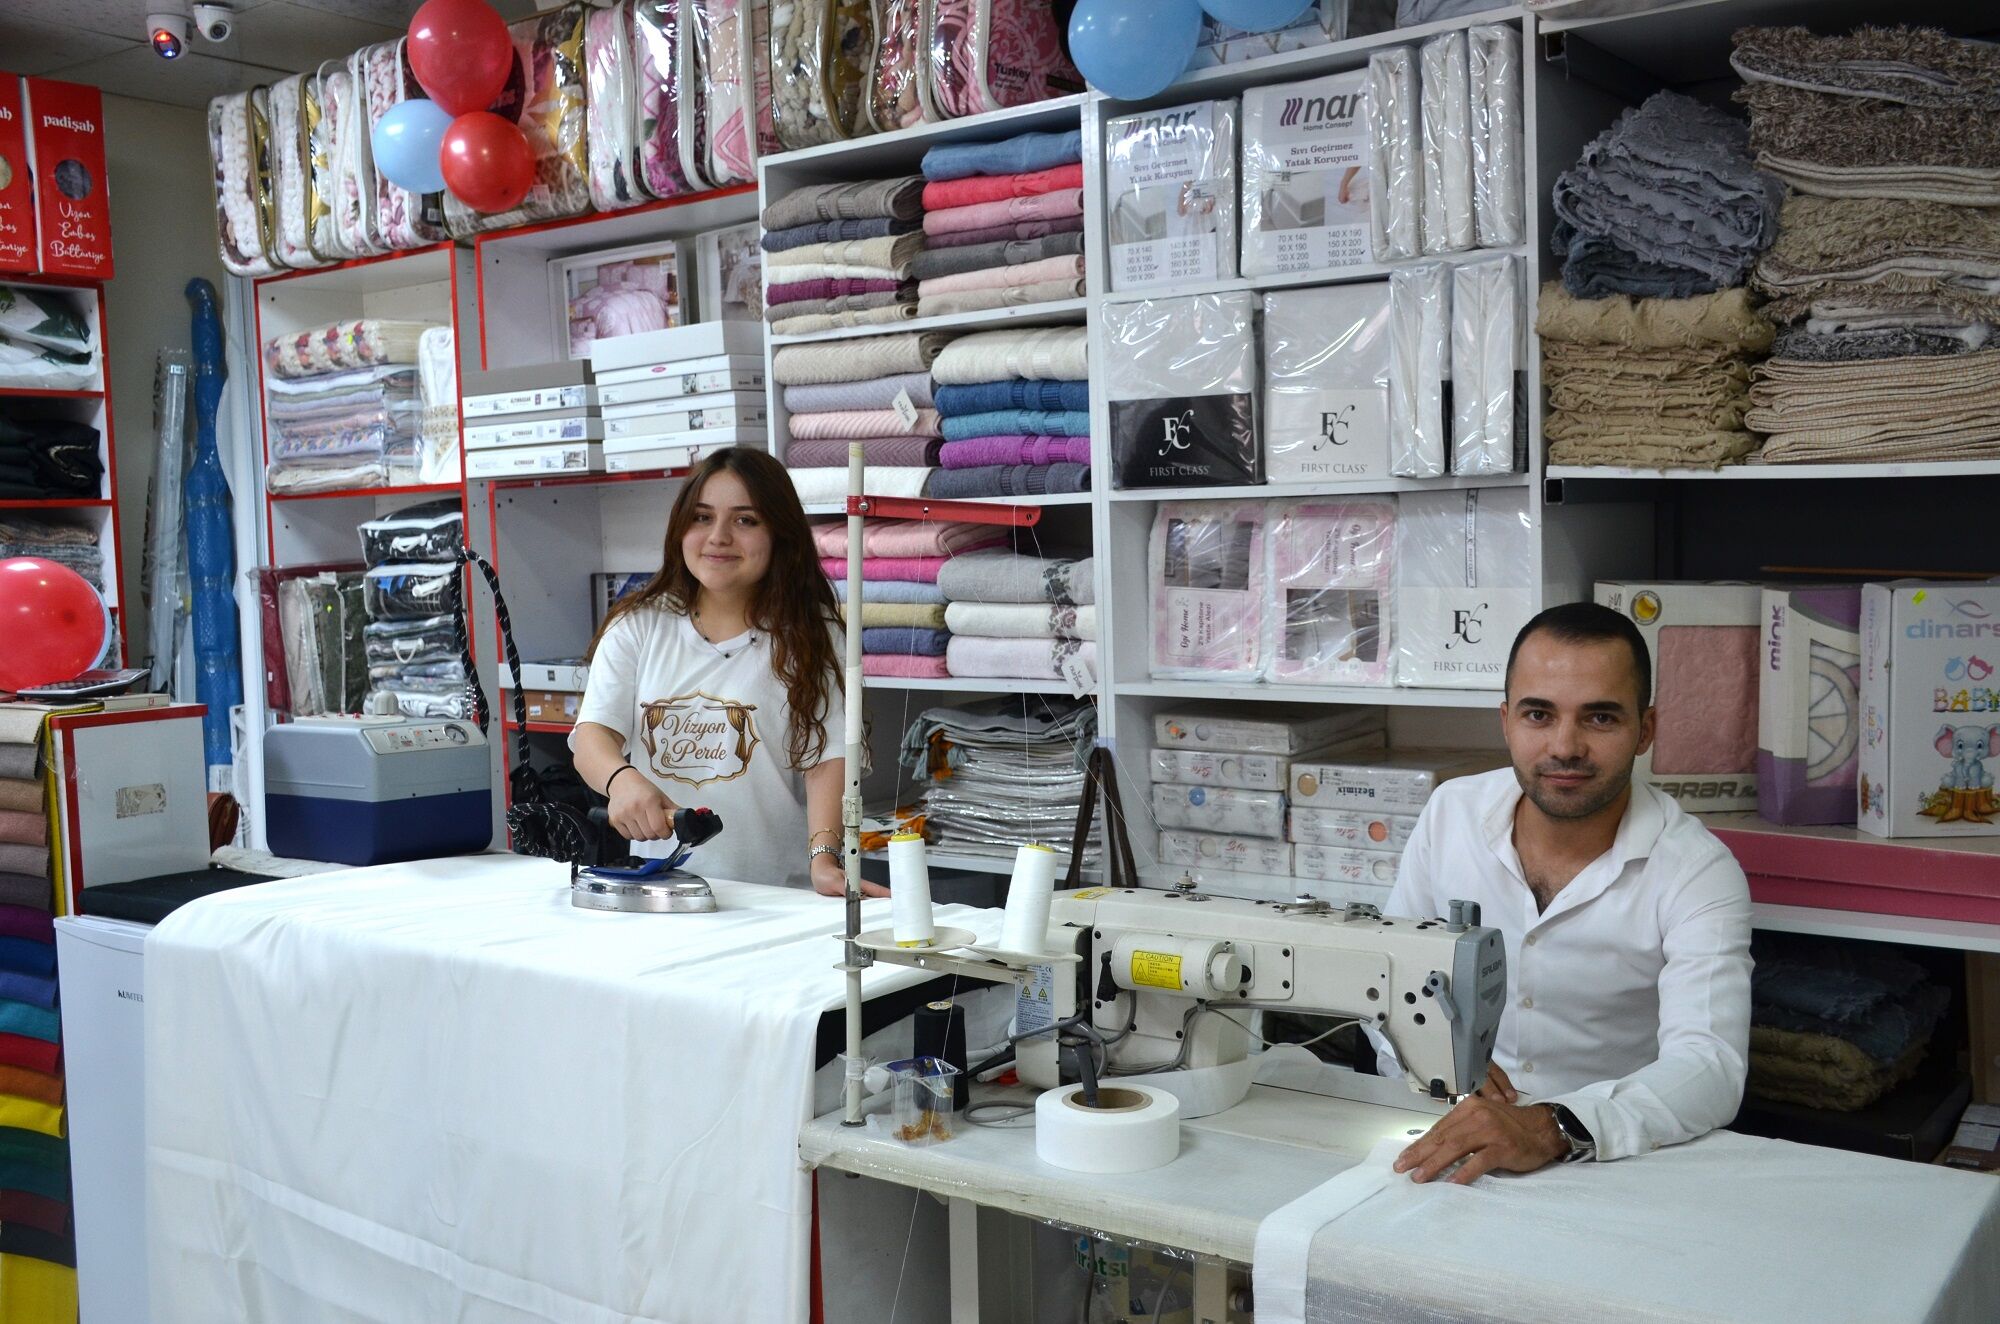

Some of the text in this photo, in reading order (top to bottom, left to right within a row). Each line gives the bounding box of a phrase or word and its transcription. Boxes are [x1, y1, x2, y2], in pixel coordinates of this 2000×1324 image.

[994, 62, 1031, 82] Turkey
[1303, 92, 1366, 123] nar
[43, 114, 95, 134] padişah
[1303, 123, 1323, 132] Home
[1285, 155, 1359, 167] Yatak Koruyucu
[59, 201, 91, 221] Vizon
[58, 221, 96, 242] Embos
[50, 240, 105, 265] Battaniye
[1150, 465, 1210, 478] FIRST CLASS
[1301, 463, 1367, 474] FIRST CLASS
[1768, 604, 1782, 671] mink
[1433, 661, 1501, 673] FIRST CLASS
[661, 711, 728, 741] Vizyon
[671, 739, 728, 763] Perde
[1337, 787, 1375, 798] Bezimix
